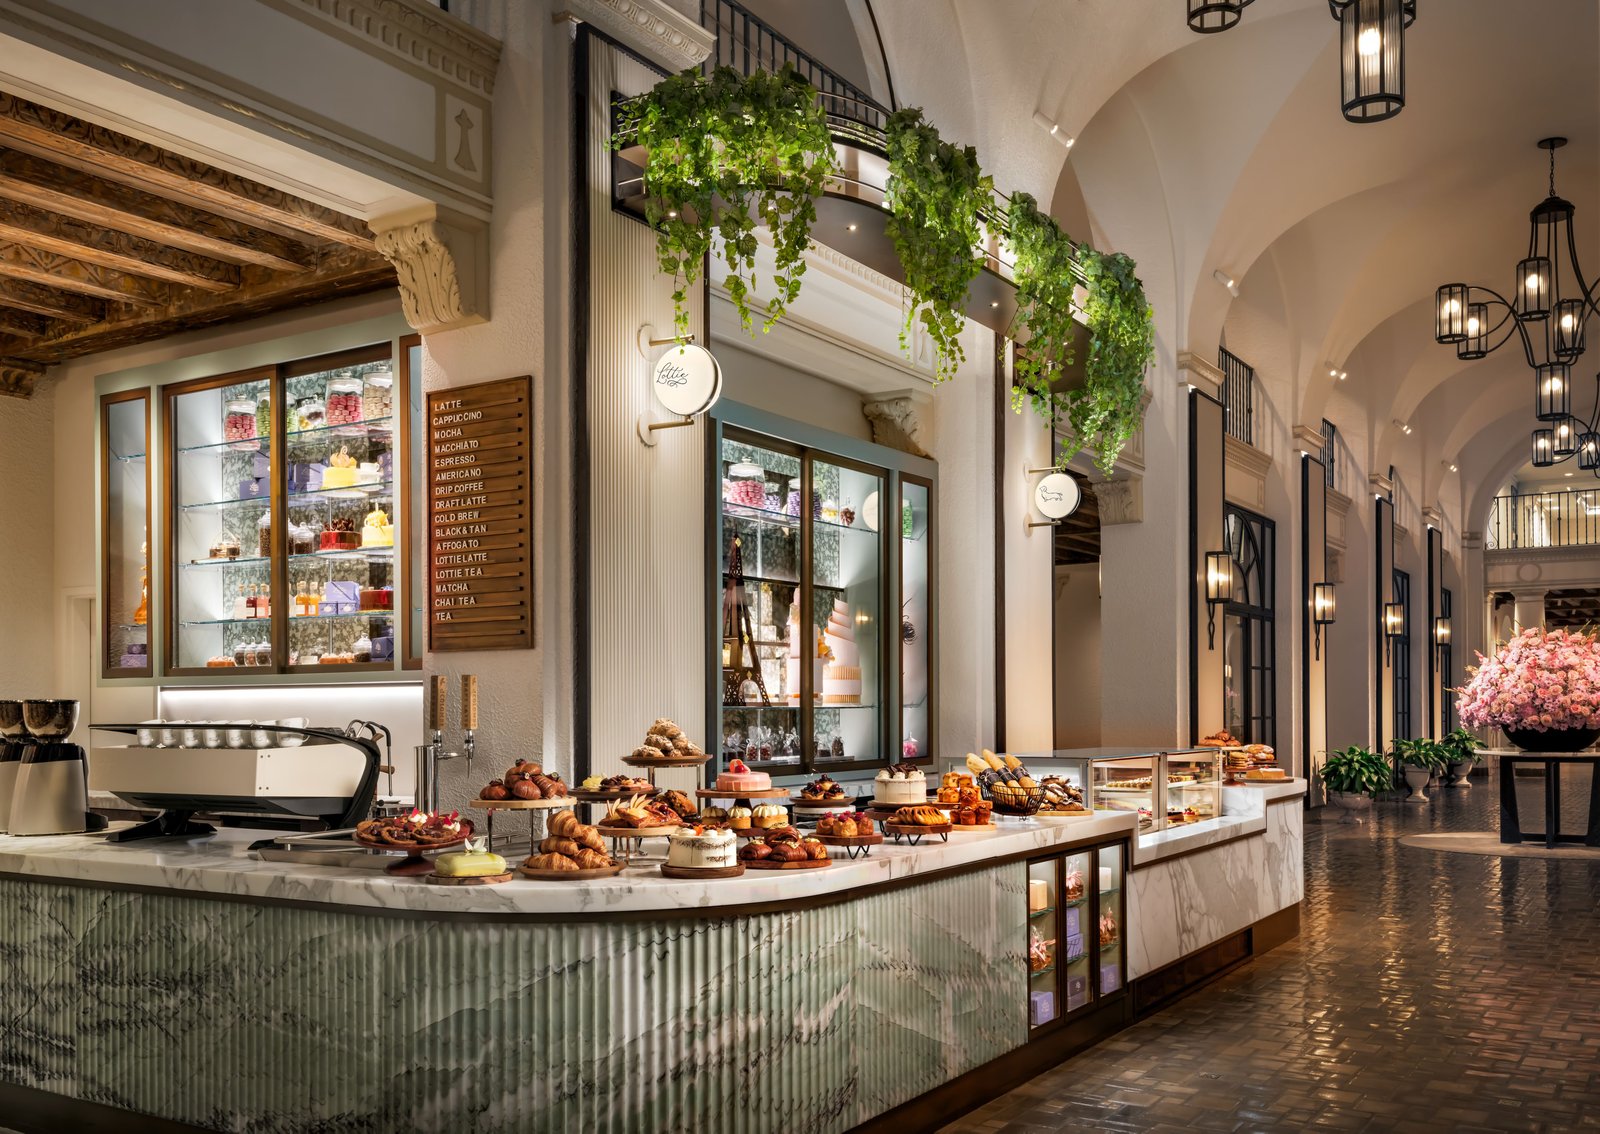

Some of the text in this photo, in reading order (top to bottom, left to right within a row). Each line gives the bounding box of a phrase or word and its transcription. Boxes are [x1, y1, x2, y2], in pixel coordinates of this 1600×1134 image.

[656, 362, 689, 387] Lottie
[435, 400, 462, 411] LATTE
[433, 411, 482, 425] CAPPUCCINO
[435, 429, 462, 439] MOCHA
[435, 440, 479, 453] MACCHIATO
[435, 455, 476, 467] ESPRESSO
[436, 468, 481, 481] AMERICANO
[436, 482, 484, 495] DRIP COFFEE
[436, 496, 486, 509] DRAFT LATTE
[435, 511, 479, 523] COLD BREW
[436, 527, 463, 537] BLACK
[470, 525, 486, 533] TAN
[436, 540, 478, 551] AFFOGATO
[436, 553, 487, 565] LOTTIE LATTE
[436, 568, 482, 579] LOTTIE TEA
[436, 583, 468, 593] MATCHA
[435, 597, 475, 606] CHAI TEA
